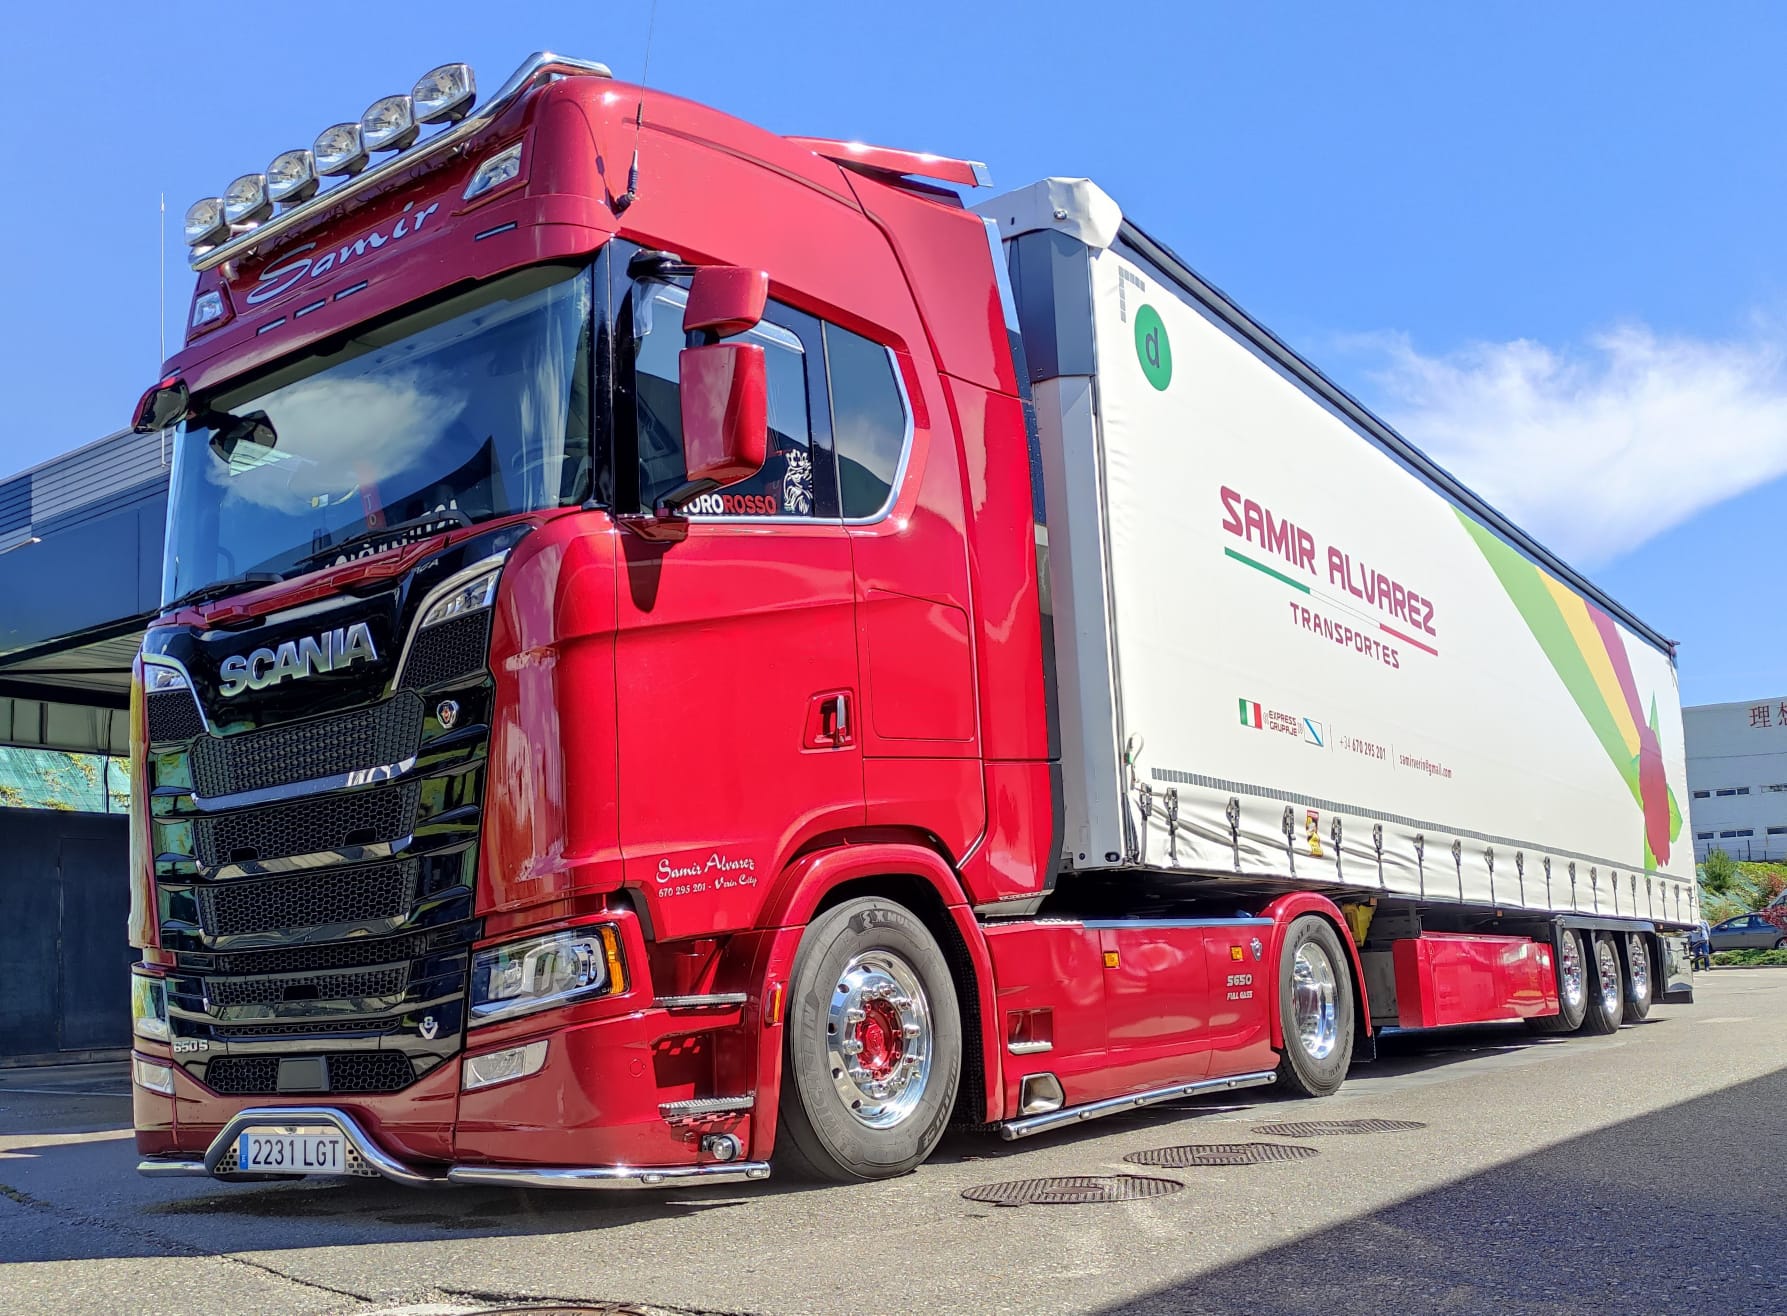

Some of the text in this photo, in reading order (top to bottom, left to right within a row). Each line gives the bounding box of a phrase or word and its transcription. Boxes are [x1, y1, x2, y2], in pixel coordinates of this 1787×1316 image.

[247, 201, 439, 304] Samir
[1220, 485, 1437, 637] SAMIR ALVAREZ
[1290, 601, 1400, 669] TRANSPORTES
[218, 622, 378, 697] SCANIA
[1268, 710, 1297, 727] EXPRESS
[1269, 721, 1298, 737] GRUPAJE
[1352, 738, 1364, 754] 670
[1364, 741, 1375, 758] 295
[1376, 745, 1386, 761] 201
[656, 853, 755, 883] Samir Alvarez
[658, 887, 673, 898] 670
[676, 885, 690, 895] 295
[693, 882, 706, 892] 201
[739, 873, 758, 887] City
[252, 1139, 339, 1167] 2231 LGT
